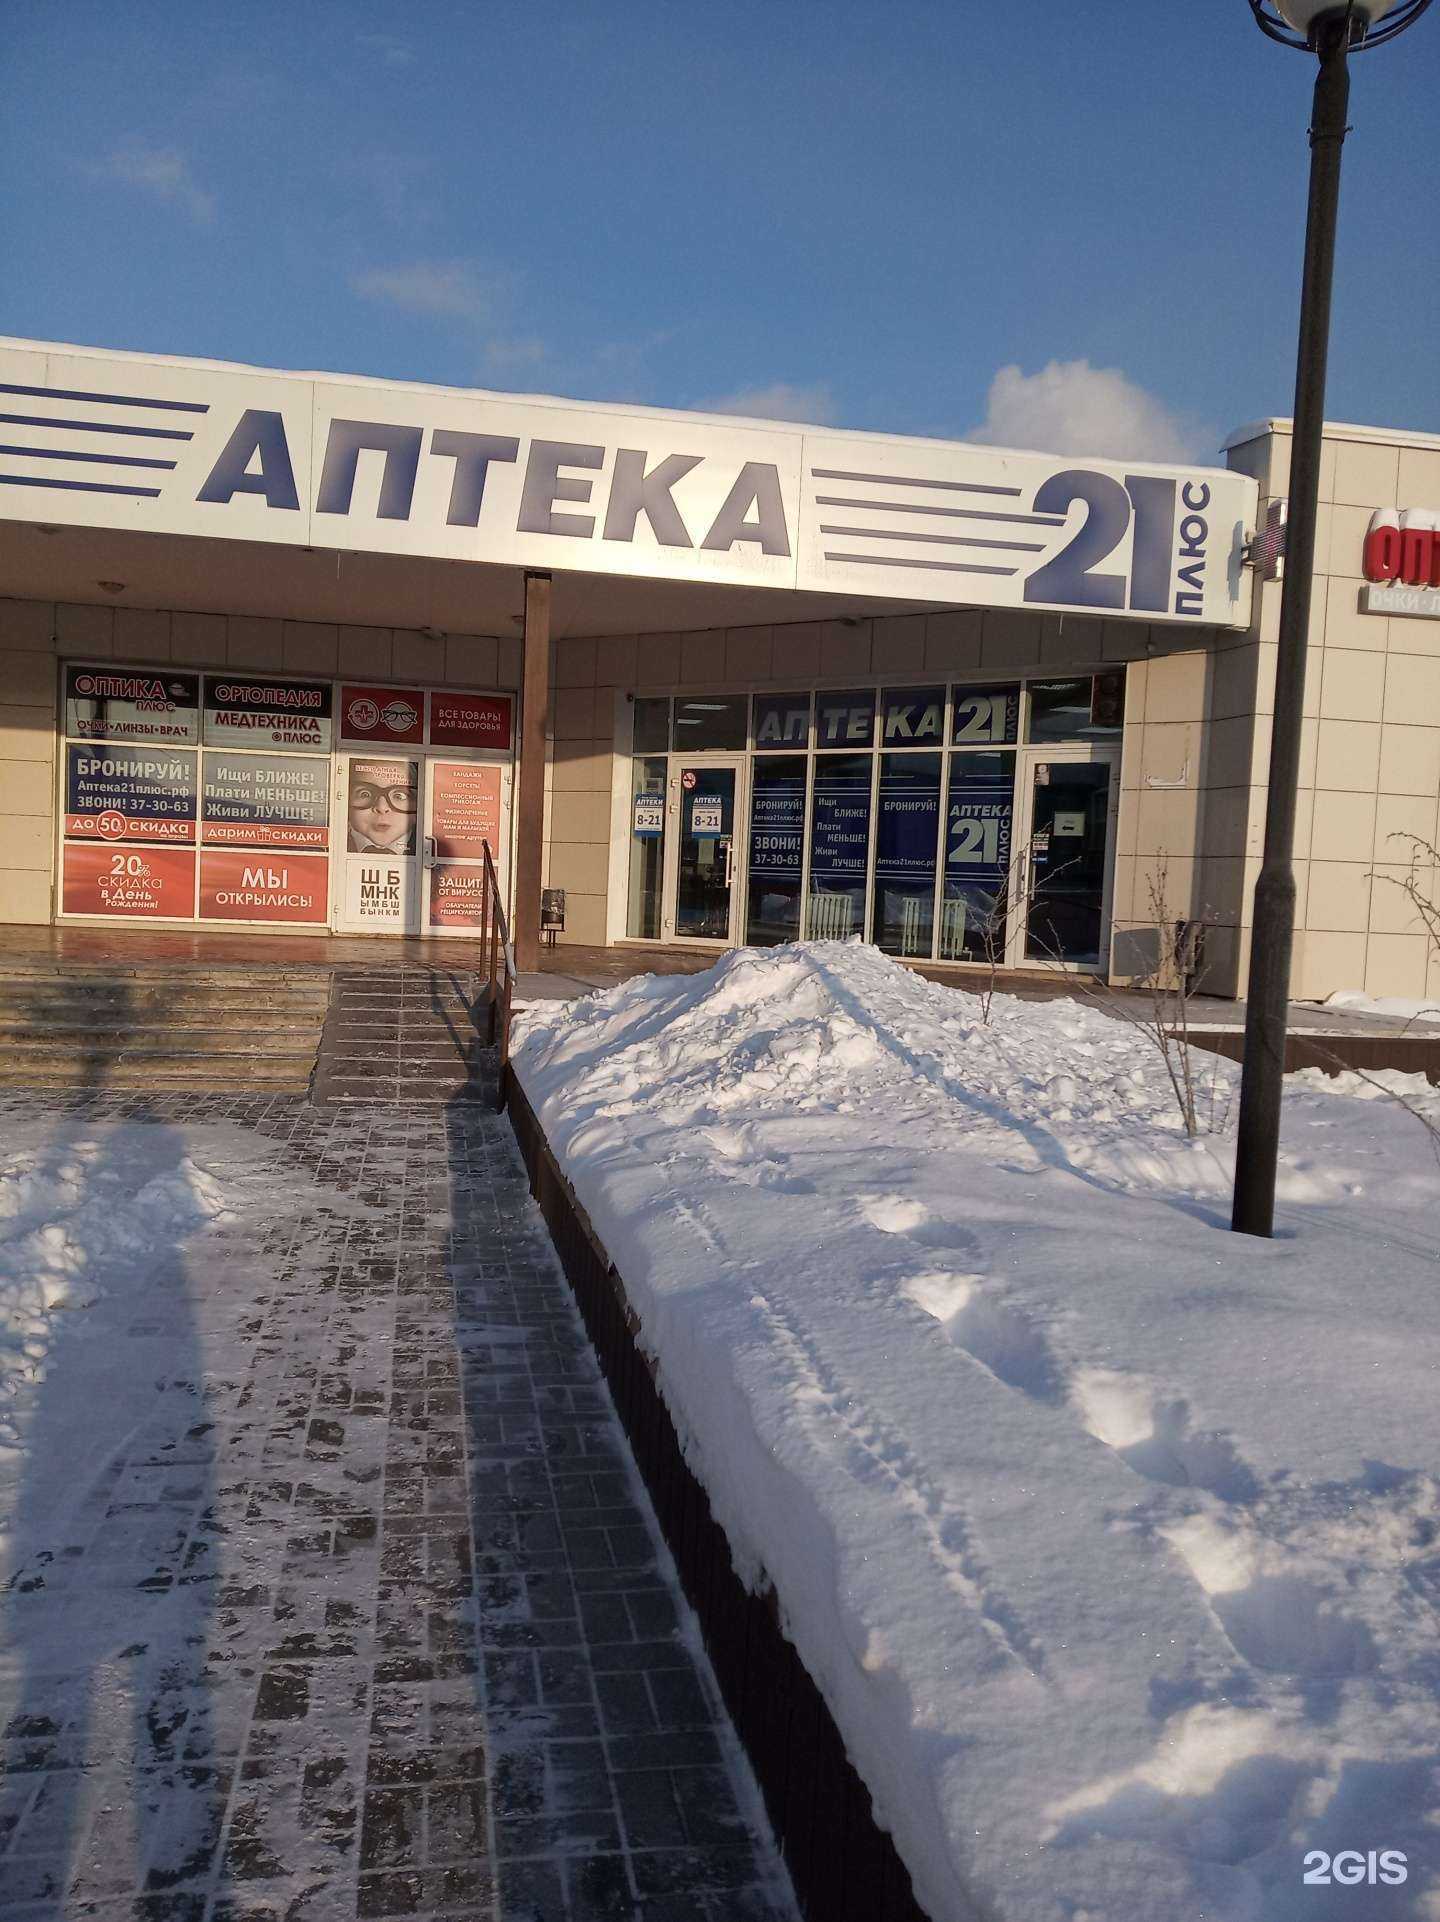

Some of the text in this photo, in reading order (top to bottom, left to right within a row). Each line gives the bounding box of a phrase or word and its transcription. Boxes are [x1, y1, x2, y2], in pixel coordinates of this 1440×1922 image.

[195, 408, 1177, 613] АПТЕКА 21
[1175, 480, 1211, 616] ПЛЮС
[1362, 516, 1440, 585] ОП
[75, 675, 167, 699] ОПТИКА
[215, 684, 322, 707] ОРТОПЕДИЯ
[136, 700, 176, 712] ПЛЮС
[215, 711, 320, 732] МЕДТЕХНИКА
[439, 709, 500, 722] ВСЕ ТОВАРЫ
[757, 696, 1007, 742] АПТЕКА 21
[438, 719, 500, 731] ДЛЯ ЗДОРОВЬЯ
[283, 732, 322, 744] ПЛЮС
[77, 758, 190, 781] БРОНИРУЙ!
[217, 767, 314, 785] Ищи БЛИЖЕ!
[78, 780, 189, 798] Аптека21плюс.рф
[205, 784, 326, 803] Плати МЕНЬШЕ!
[77, 796, 189, 813] ЗВОНИ! 37-30-63
[755, 799, 803, 810] БРОНИРУЙ!
[818, 797, 837, 807] Ищи
[884, 799, 936, 811] БРОНИРУЙ!
[206, 803, 314, 820] Живи ЛУЧШЕ!
[834, 808, 867, 817] БЛИЖЕ!
[949, 804, 1011, 817] АПТЕКА
[637, 814, 661, 825] 8-21
[694, 815, 719, 827] 8-21
[816, 822, 841, 831] Плати
[754, 837, 800, 850] ЗВОНИ!
[827, 833, 866, 843] МЕНЬШЕ!
[948, 818, 1000, 863] 21
[998, 820, 1010, 864] ПЛЮС
[814, 846, 838, 856] Живи
[110, 854, 150, 877] 20%
[754, 853, 799, 865] 37-30-63
[831, 858, 865, 868] ЛУЧШЕ!
[241, 867, 288, 889] МЫ
[439, 877, 483, 889] ЗАЩИТ
[113, 888, 152, 901] День
[438, 888, 450, 896] ОТ
[216, 892, 312, 907] ОТКРЫЛИСЬ!
